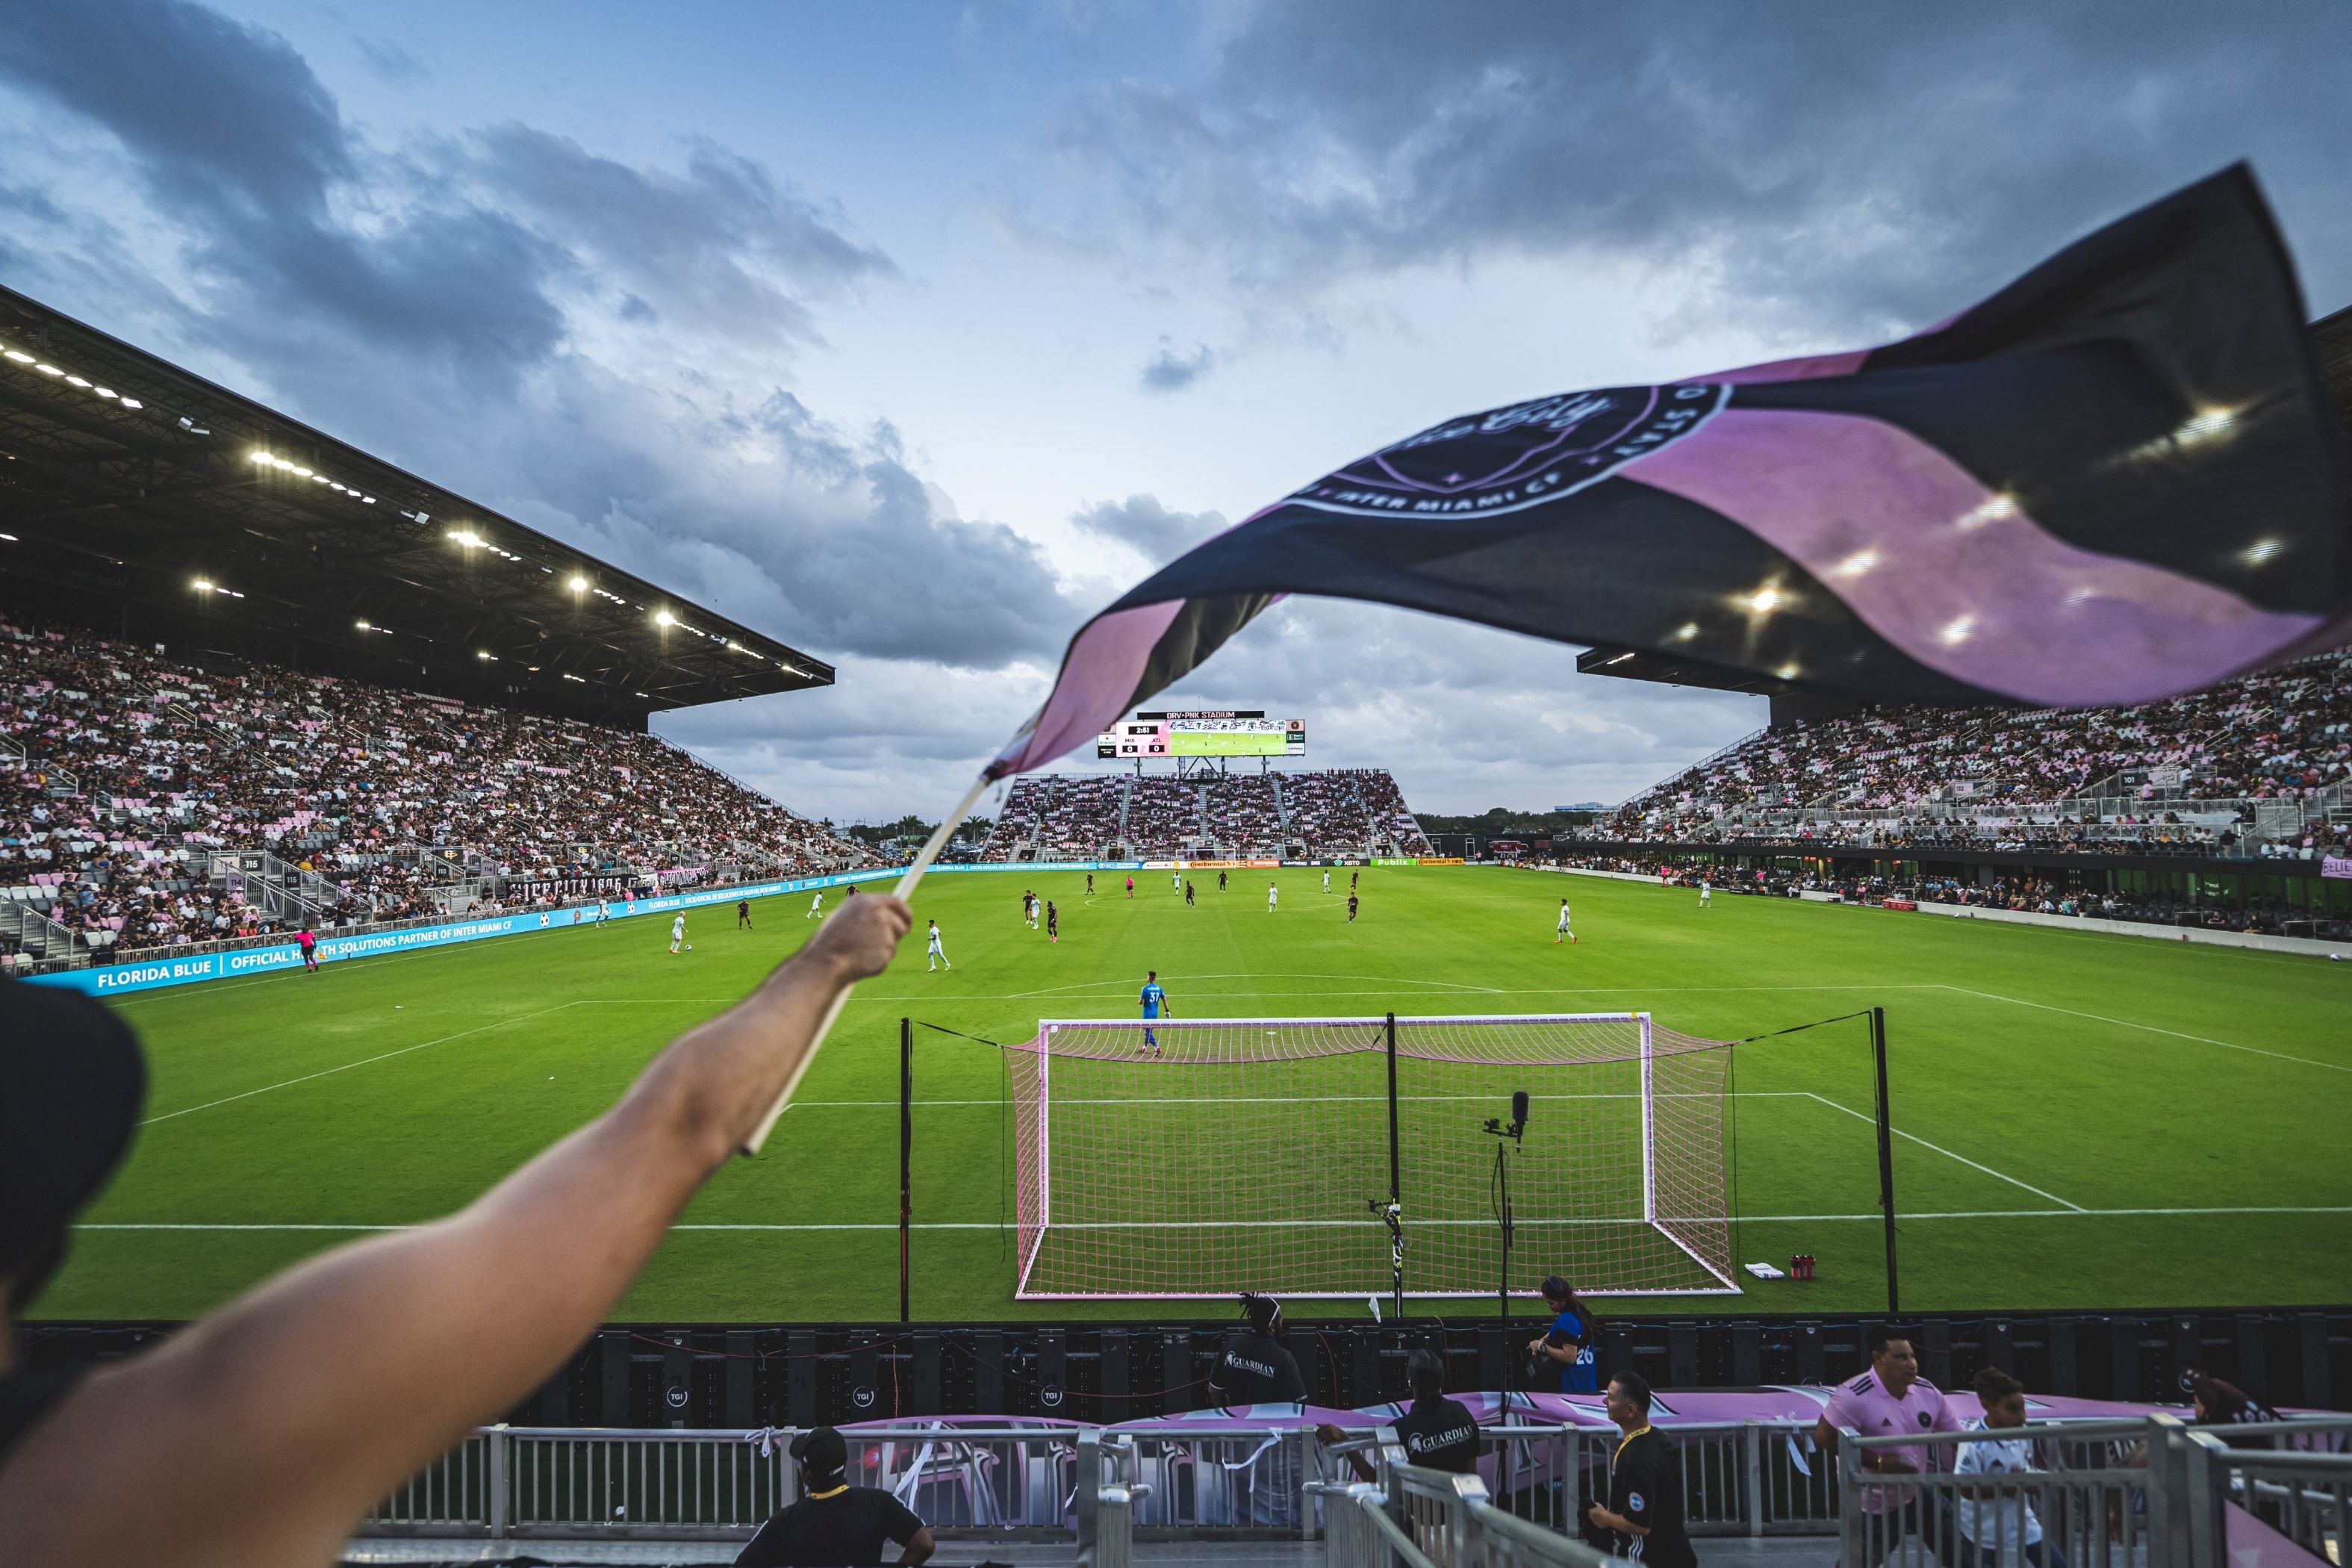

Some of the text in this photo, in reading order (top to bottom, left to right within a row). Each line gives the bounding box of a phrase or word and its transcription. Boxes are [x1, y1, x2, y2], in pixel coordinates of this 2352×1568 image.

[1413, 489, 1516, 512] MIAMI
[1525, 470, 1562, 494] CF
[246, 859, 258, 869] 115
[287, 876, 297, 884] 115
[553, 878, 588, 899] CITY
[649, 900, 669, 909] FLORIDA
[669, 898, 680, 906] BLUE
[684, 896, 697, 904] SOCIO
[97, 968, 170, 988] FLORIDA
[174, 960, 211, 977] BLUE
[231, 951, 289, 969] OFFICIAL
[338, 936, 396, 953] SOLUTIONS
[398, 931, 439, 946] PARTNER
[440, 928, 452, 942] OF
[453, 925, 478, 937] INTER
[478, 921, 502, 933] MIAMI
[503, 920, 512, 930] CF
[1575, 1348, 1593, 1365] 26
[1233, 1357, 1275, 1375] GUARDIAN
[1422, 1424, 1473, 1449] GUARDIAN
